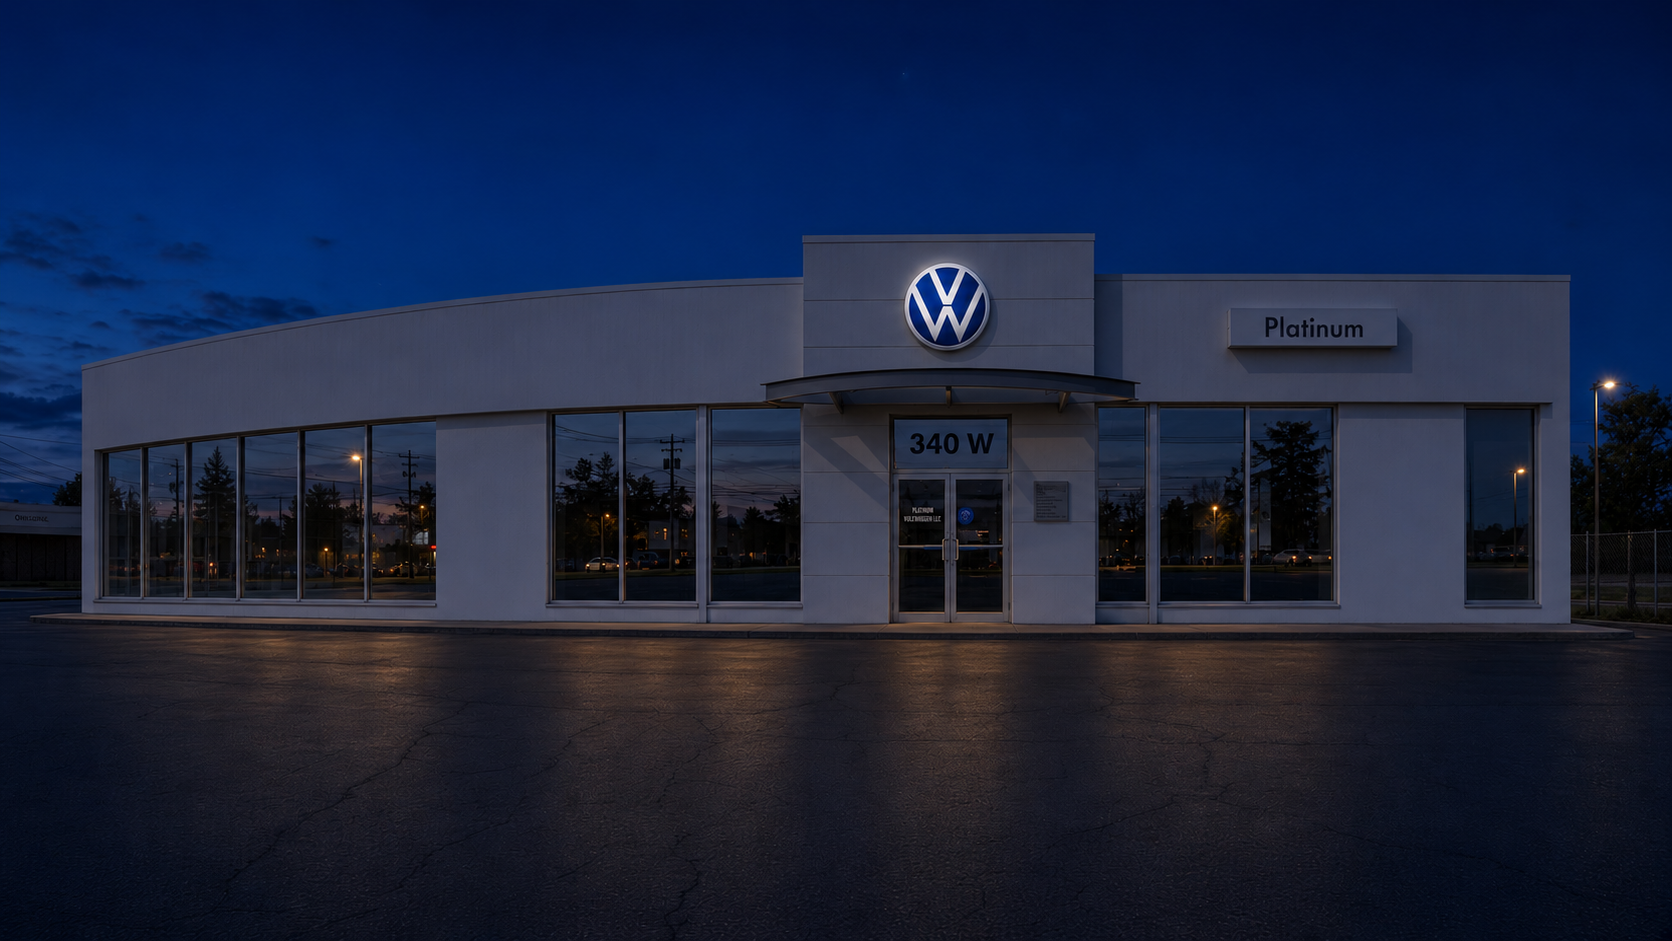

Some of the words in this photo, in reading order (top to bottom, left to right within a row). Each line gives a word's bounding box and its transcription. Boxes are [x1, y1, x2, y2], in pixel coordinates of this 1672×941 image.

[1265, 316, 1364, 338] Platinum
[909, 432, 960, 455] 340
[966, 432, 995, 455] W
